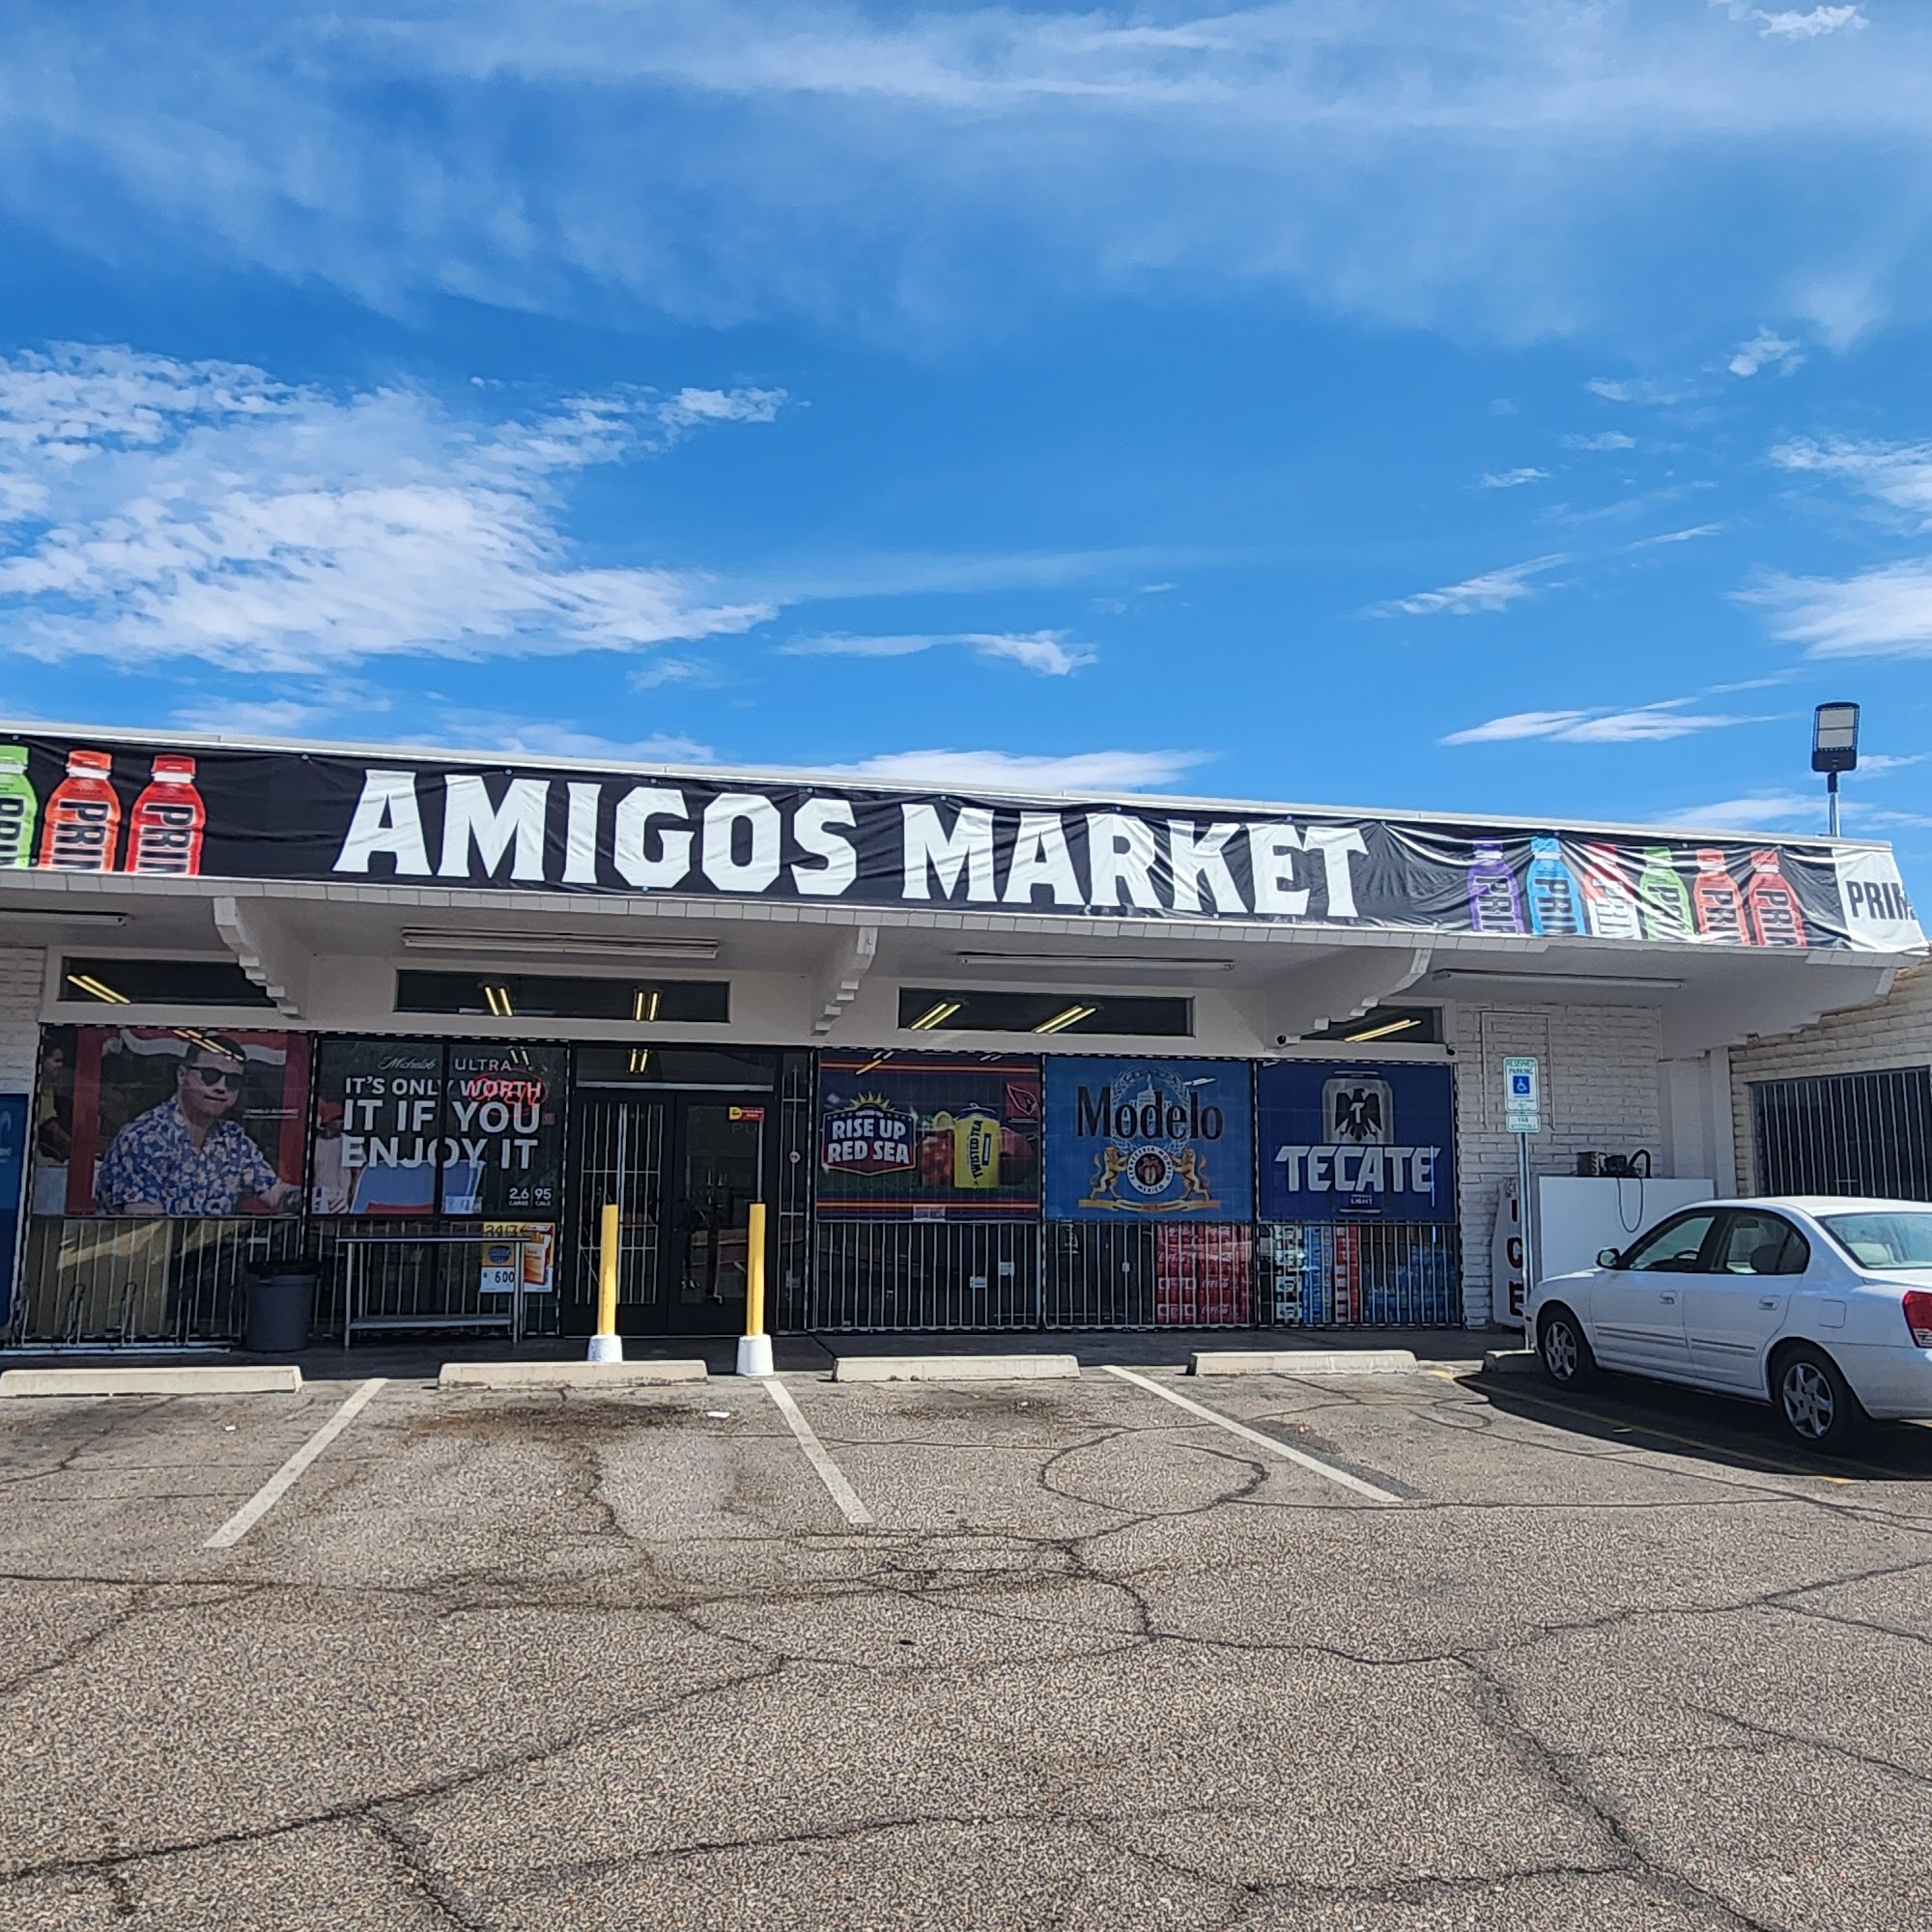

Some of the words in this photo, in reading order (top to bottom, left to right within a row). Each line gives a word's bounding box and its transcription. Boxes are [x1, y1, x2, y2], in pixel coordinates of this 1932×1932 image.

[332, 769, 858, 895] AMIGOS
[901, 803, 1370, 918] MARKET
[1701, 889, 1743, 944] PRI
[378, 1057, 437, 1070] Michelob
[454, 1058, 512, 1071] ULTRA
[346, 1075, 385, 1094] IT'S
[460, 1079, 542, 1098] WORTH
[343, 1098, 384, 1131] IT
[397, 1099, 436, 1132] IF
[451, 1099, 541, 1134] YOU
[832, 1118, 875, 1140] RISE
[879, 1118, 906, 1140] UP
[970, 1120, 983, 1137] TEA
[1077, 1085, 1223, 1140] Modelo
[341, 1136, 489, 1169] ENJOY
[500, 1138, 539, 1170] IT
[827, 1140, 868, 1164] RED
[872, 1140, 910, 1165] SEA
[969, 1138, 983, 1179] TWISTED
[1274, 1146, 1441, 1193] TECATE
[534, 1187, 553, 1200] 95
[1507, 1199, 1524, 1317] ICE
